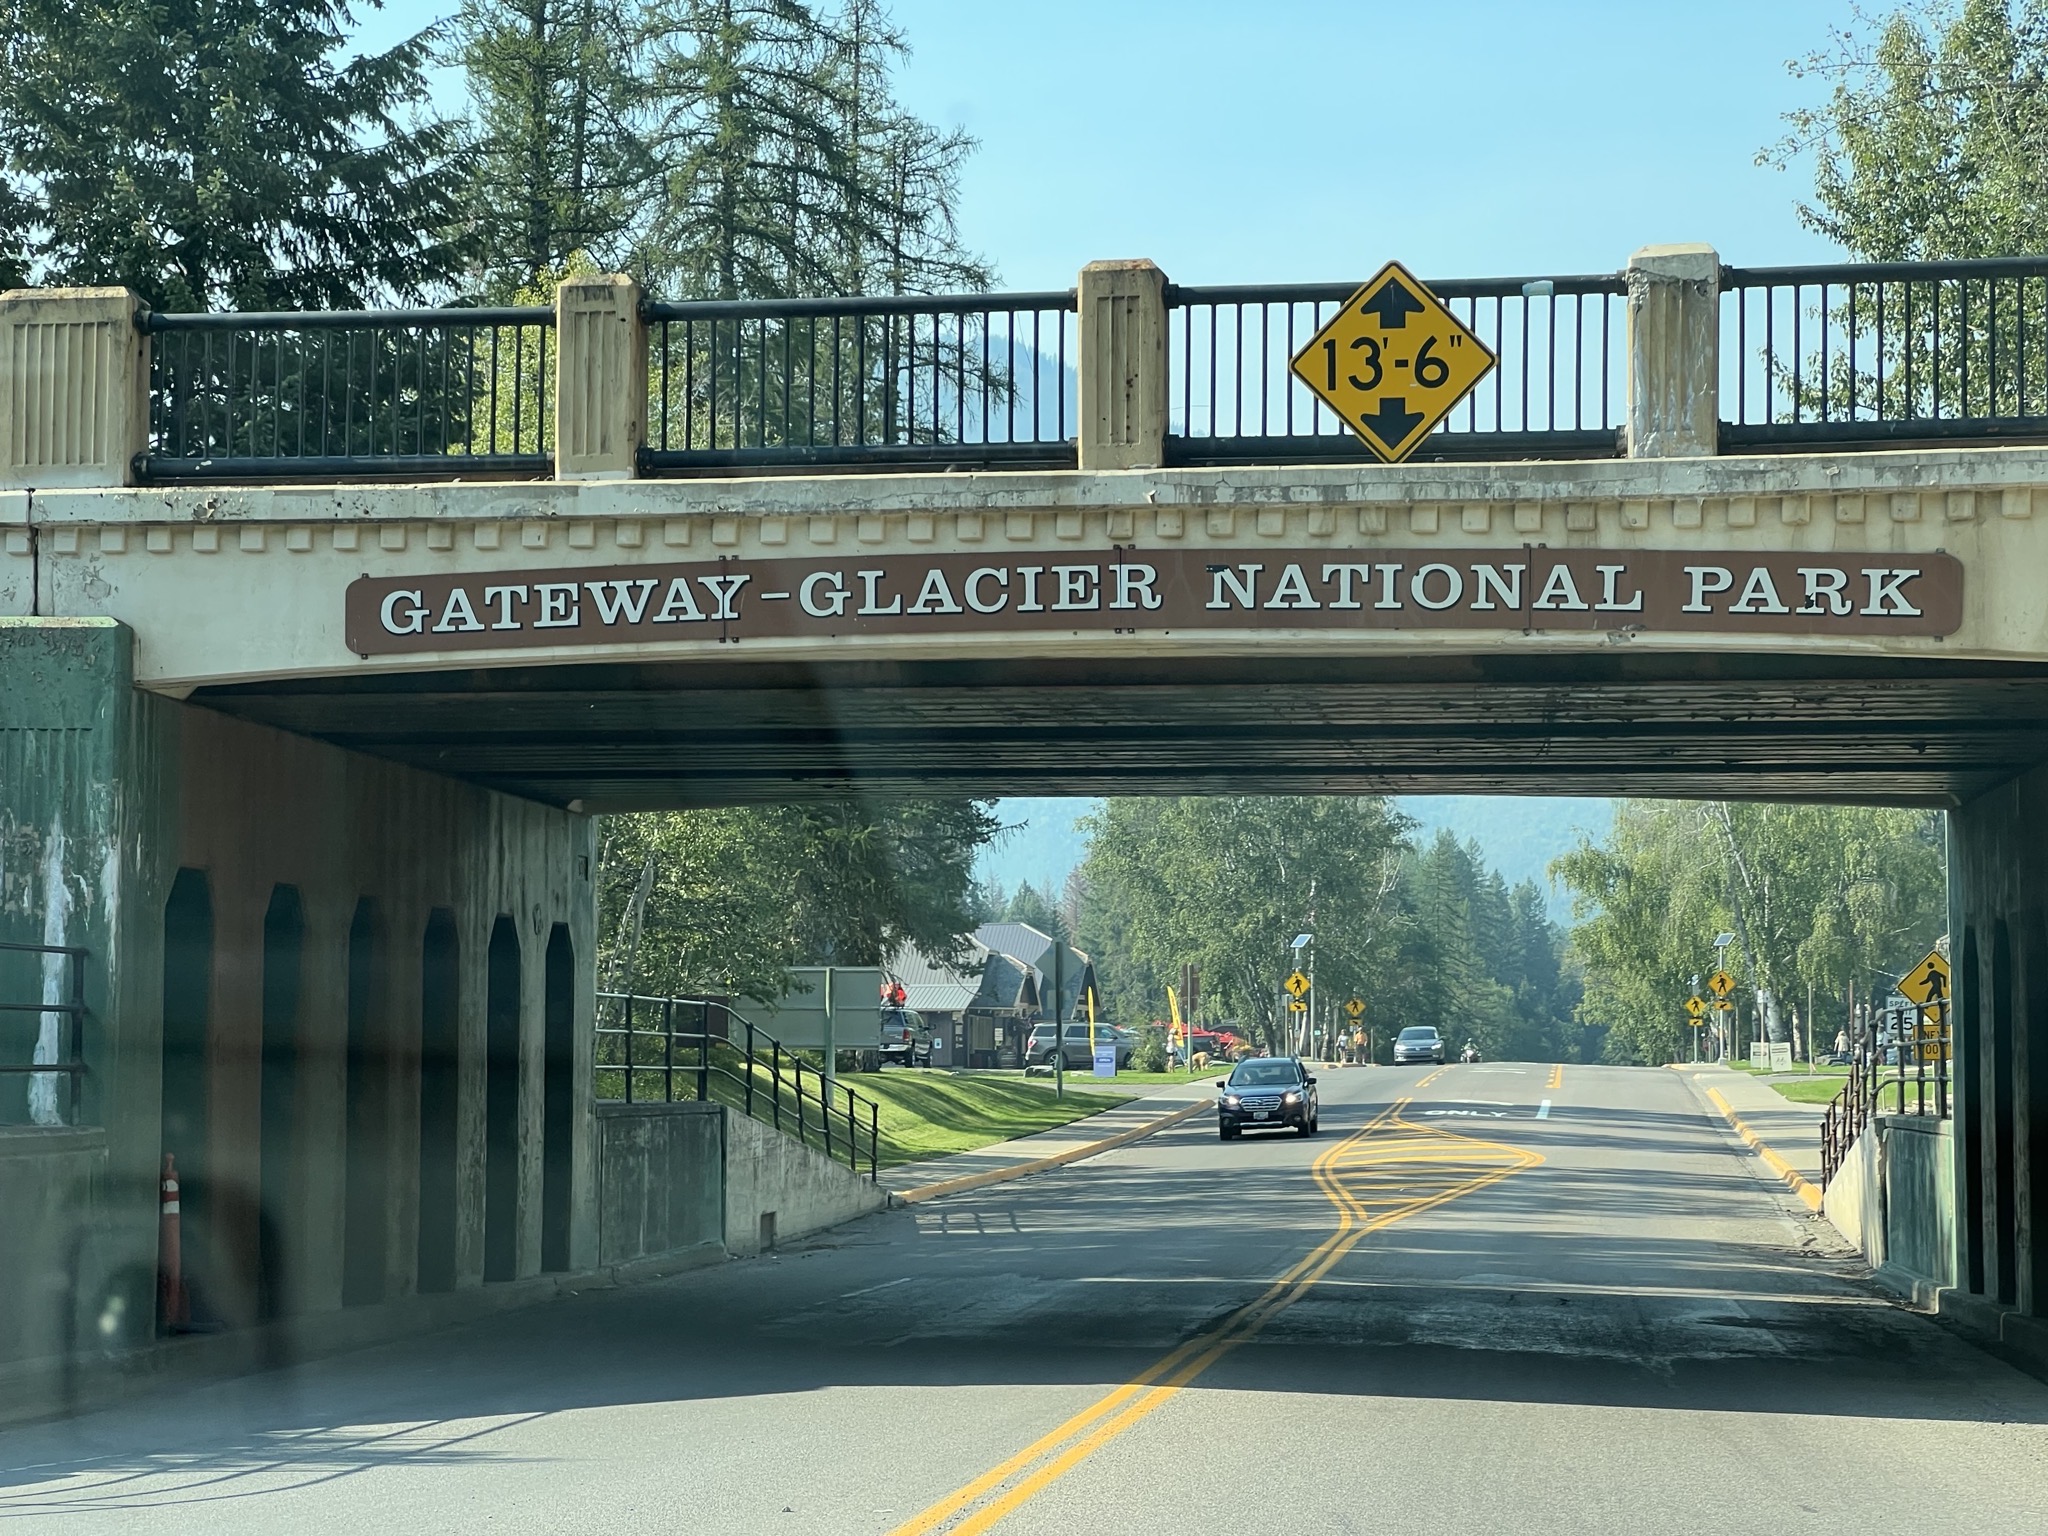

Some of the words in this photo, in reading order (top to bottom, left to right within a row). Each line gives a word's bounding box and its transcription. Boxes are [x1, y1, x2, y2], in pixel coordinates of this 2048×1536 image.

[1206, 564, 1643, 612] NATIONAL
[1681, 566, 1922, 617] PARK
[1891, 1017, 1913, 1030] 25
